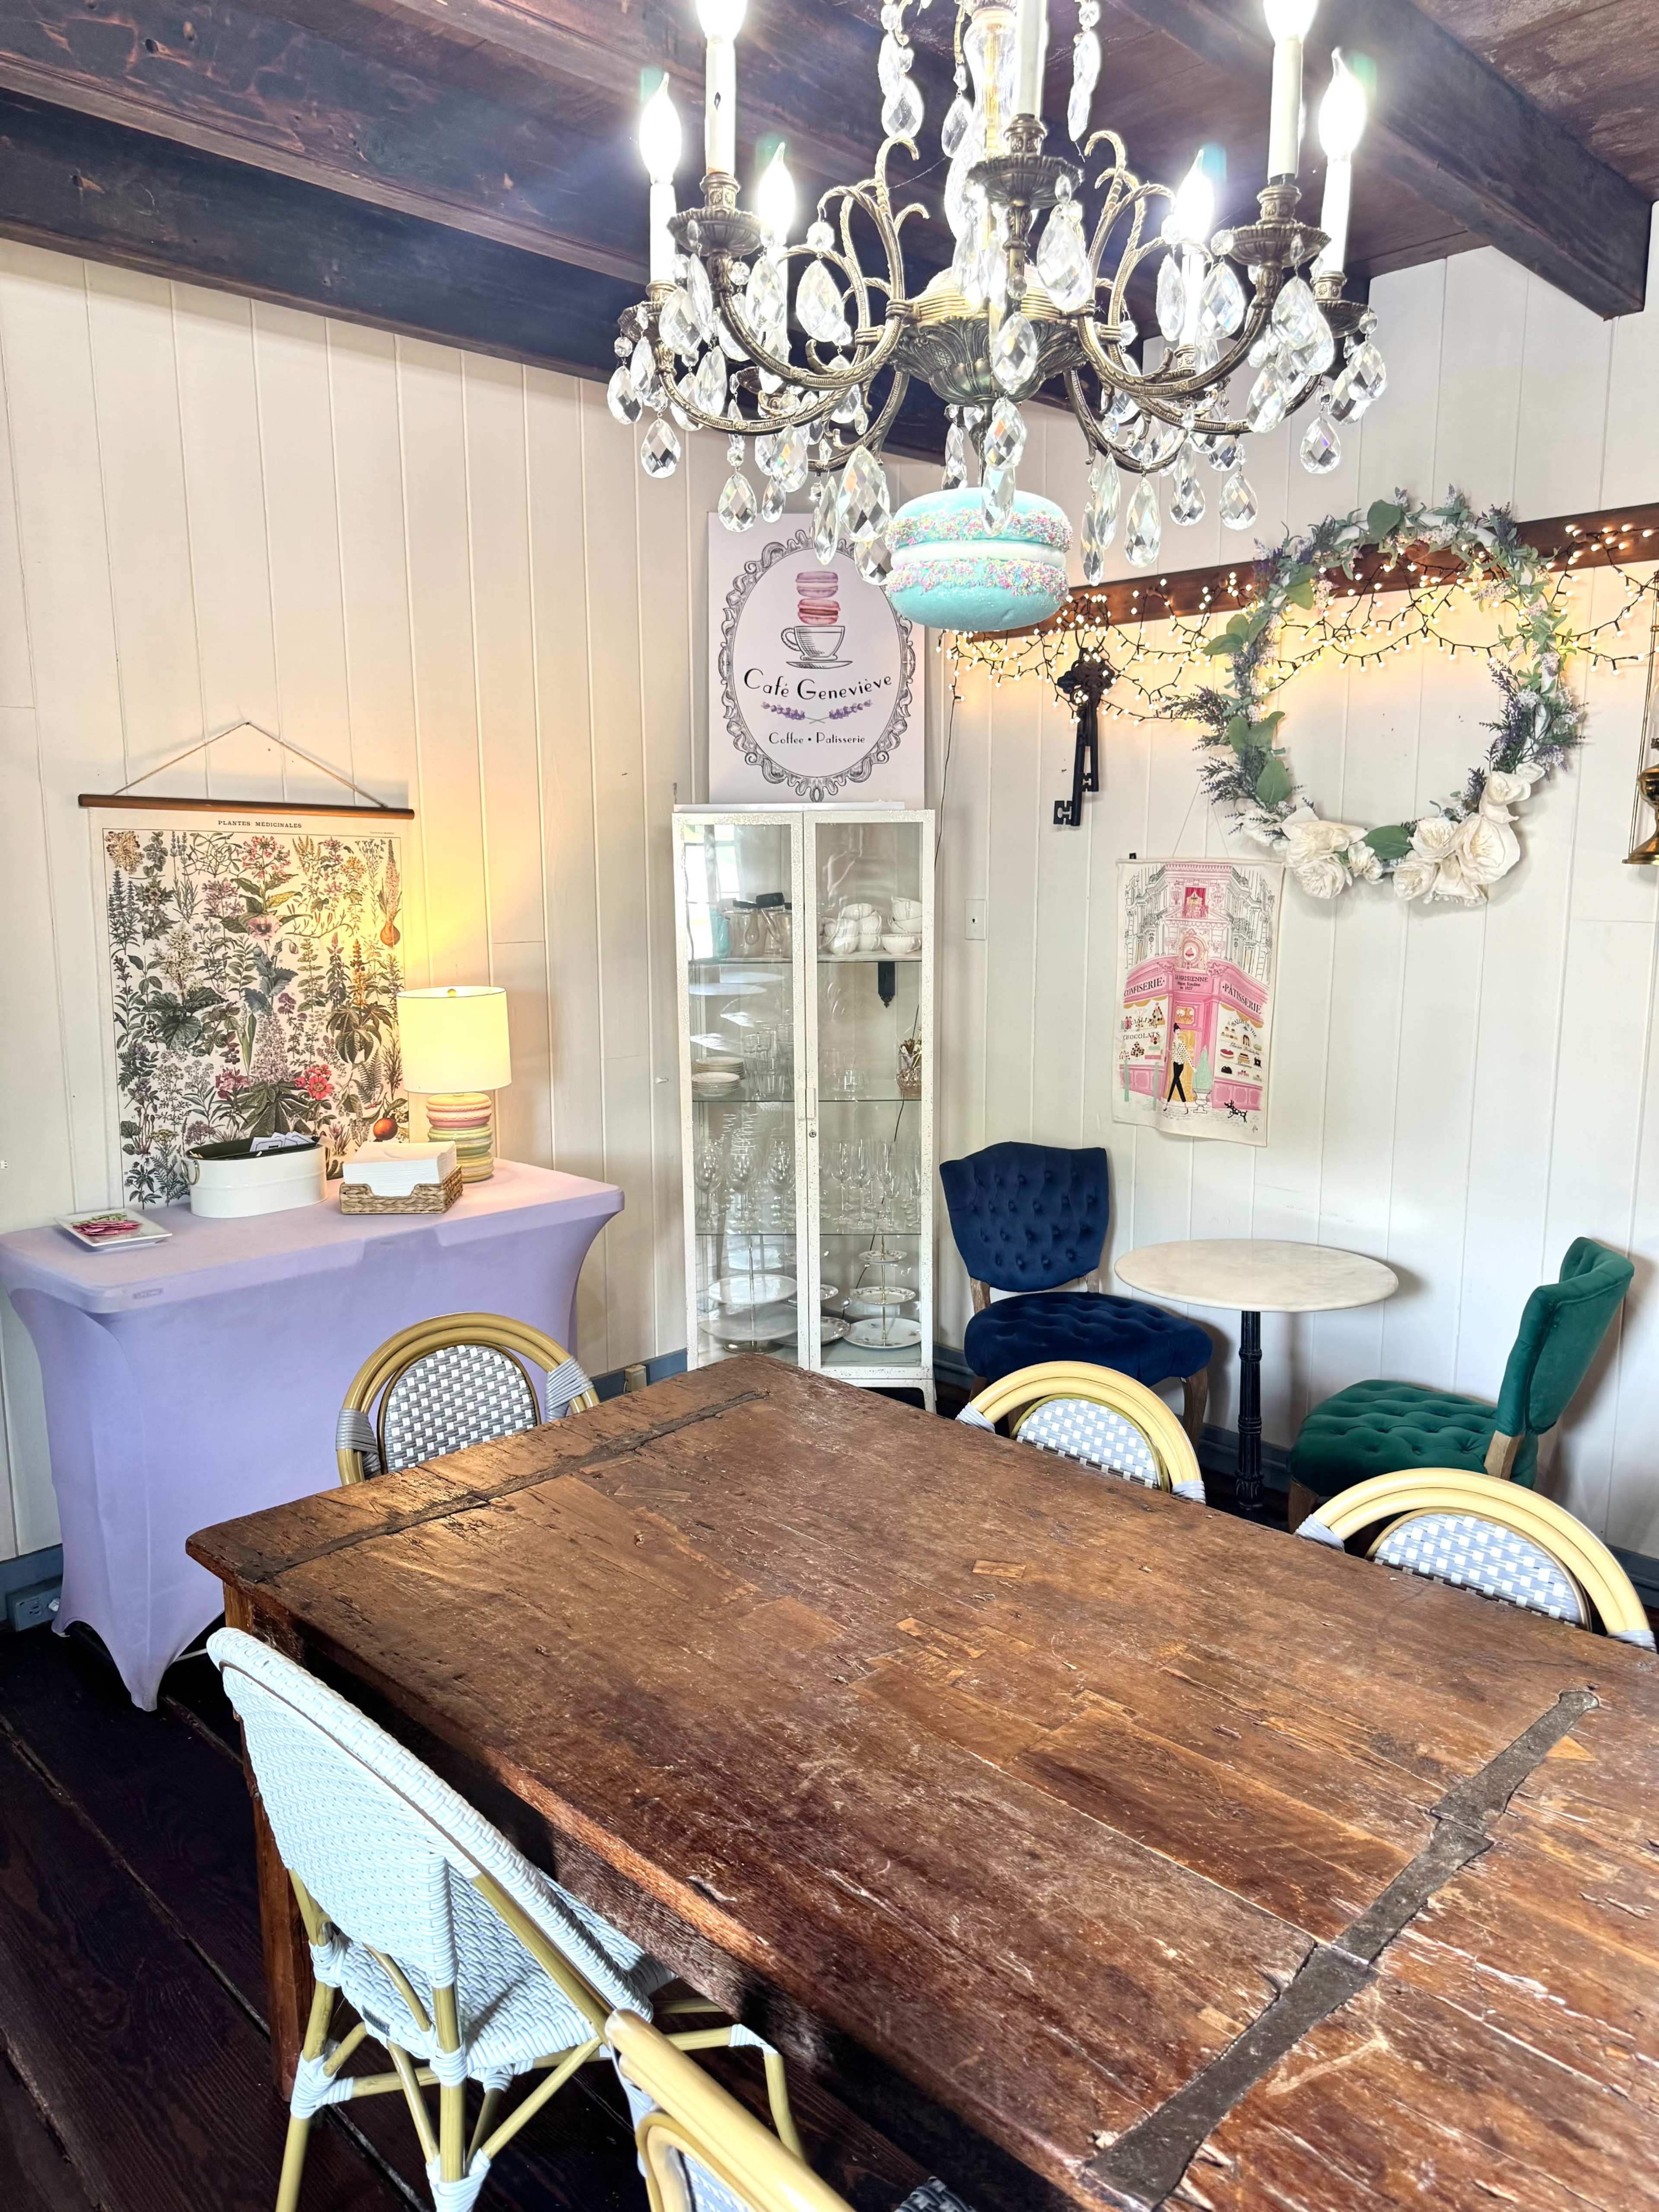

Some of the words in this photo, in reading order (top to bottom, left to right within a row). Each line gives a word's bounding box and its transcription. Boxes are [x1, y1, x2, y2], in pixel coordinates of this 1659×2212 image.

[744, 668, 789, 697] Café
[797, 676, 892, 700] Geneviève
[769, 732, 804, 744] Coffee
[817, 732, 865, 744] Patisserie
[1123, 1032, 1160, 1040] CHOCOLATS
